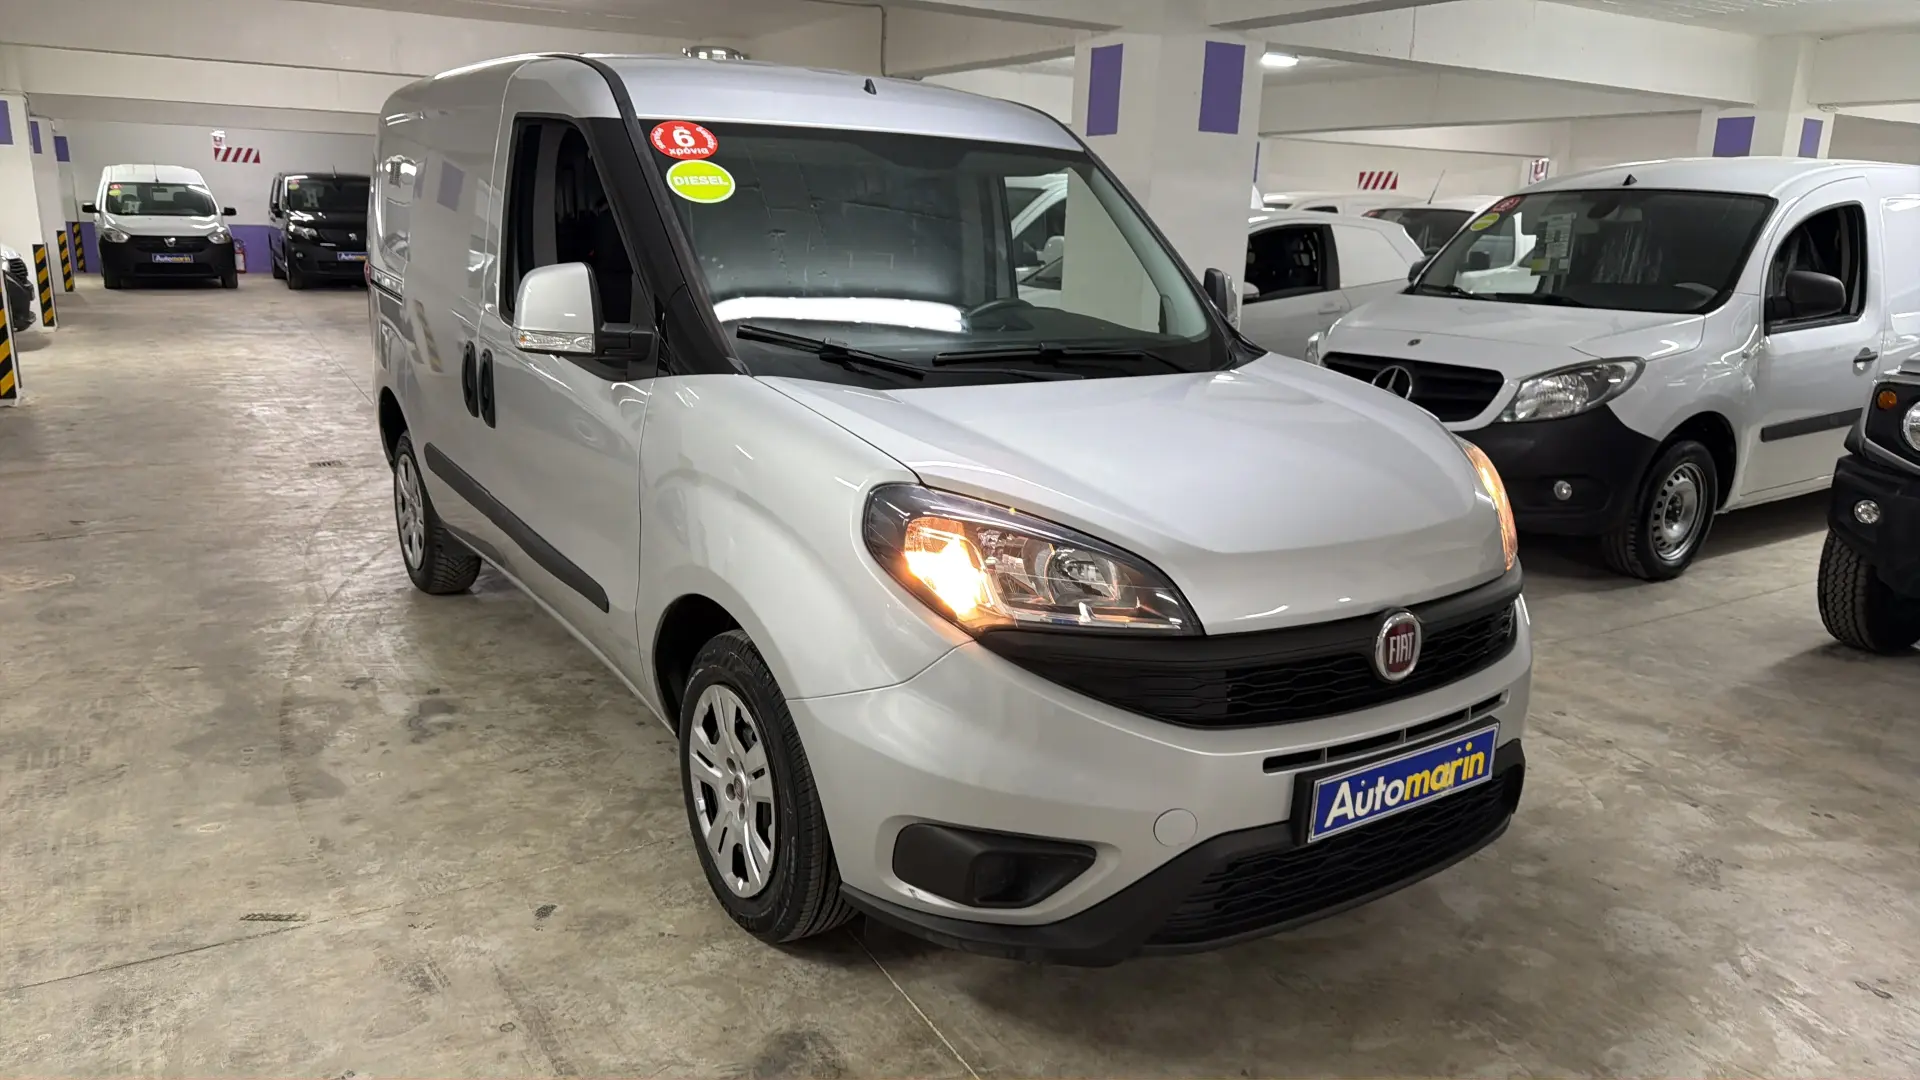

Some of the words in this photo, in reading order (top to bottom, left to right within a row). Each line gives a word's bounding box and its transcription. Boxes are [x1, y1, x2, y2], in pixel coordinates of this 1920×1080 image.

[673, 129, 695, 147] 6
[669, 147, 709, 156] χρόνια
[673, 175, 728, 186] DIESEL
[1389, 632, 1414, 664] FIAT
[1324, 742, 1485, 828] Automarin
